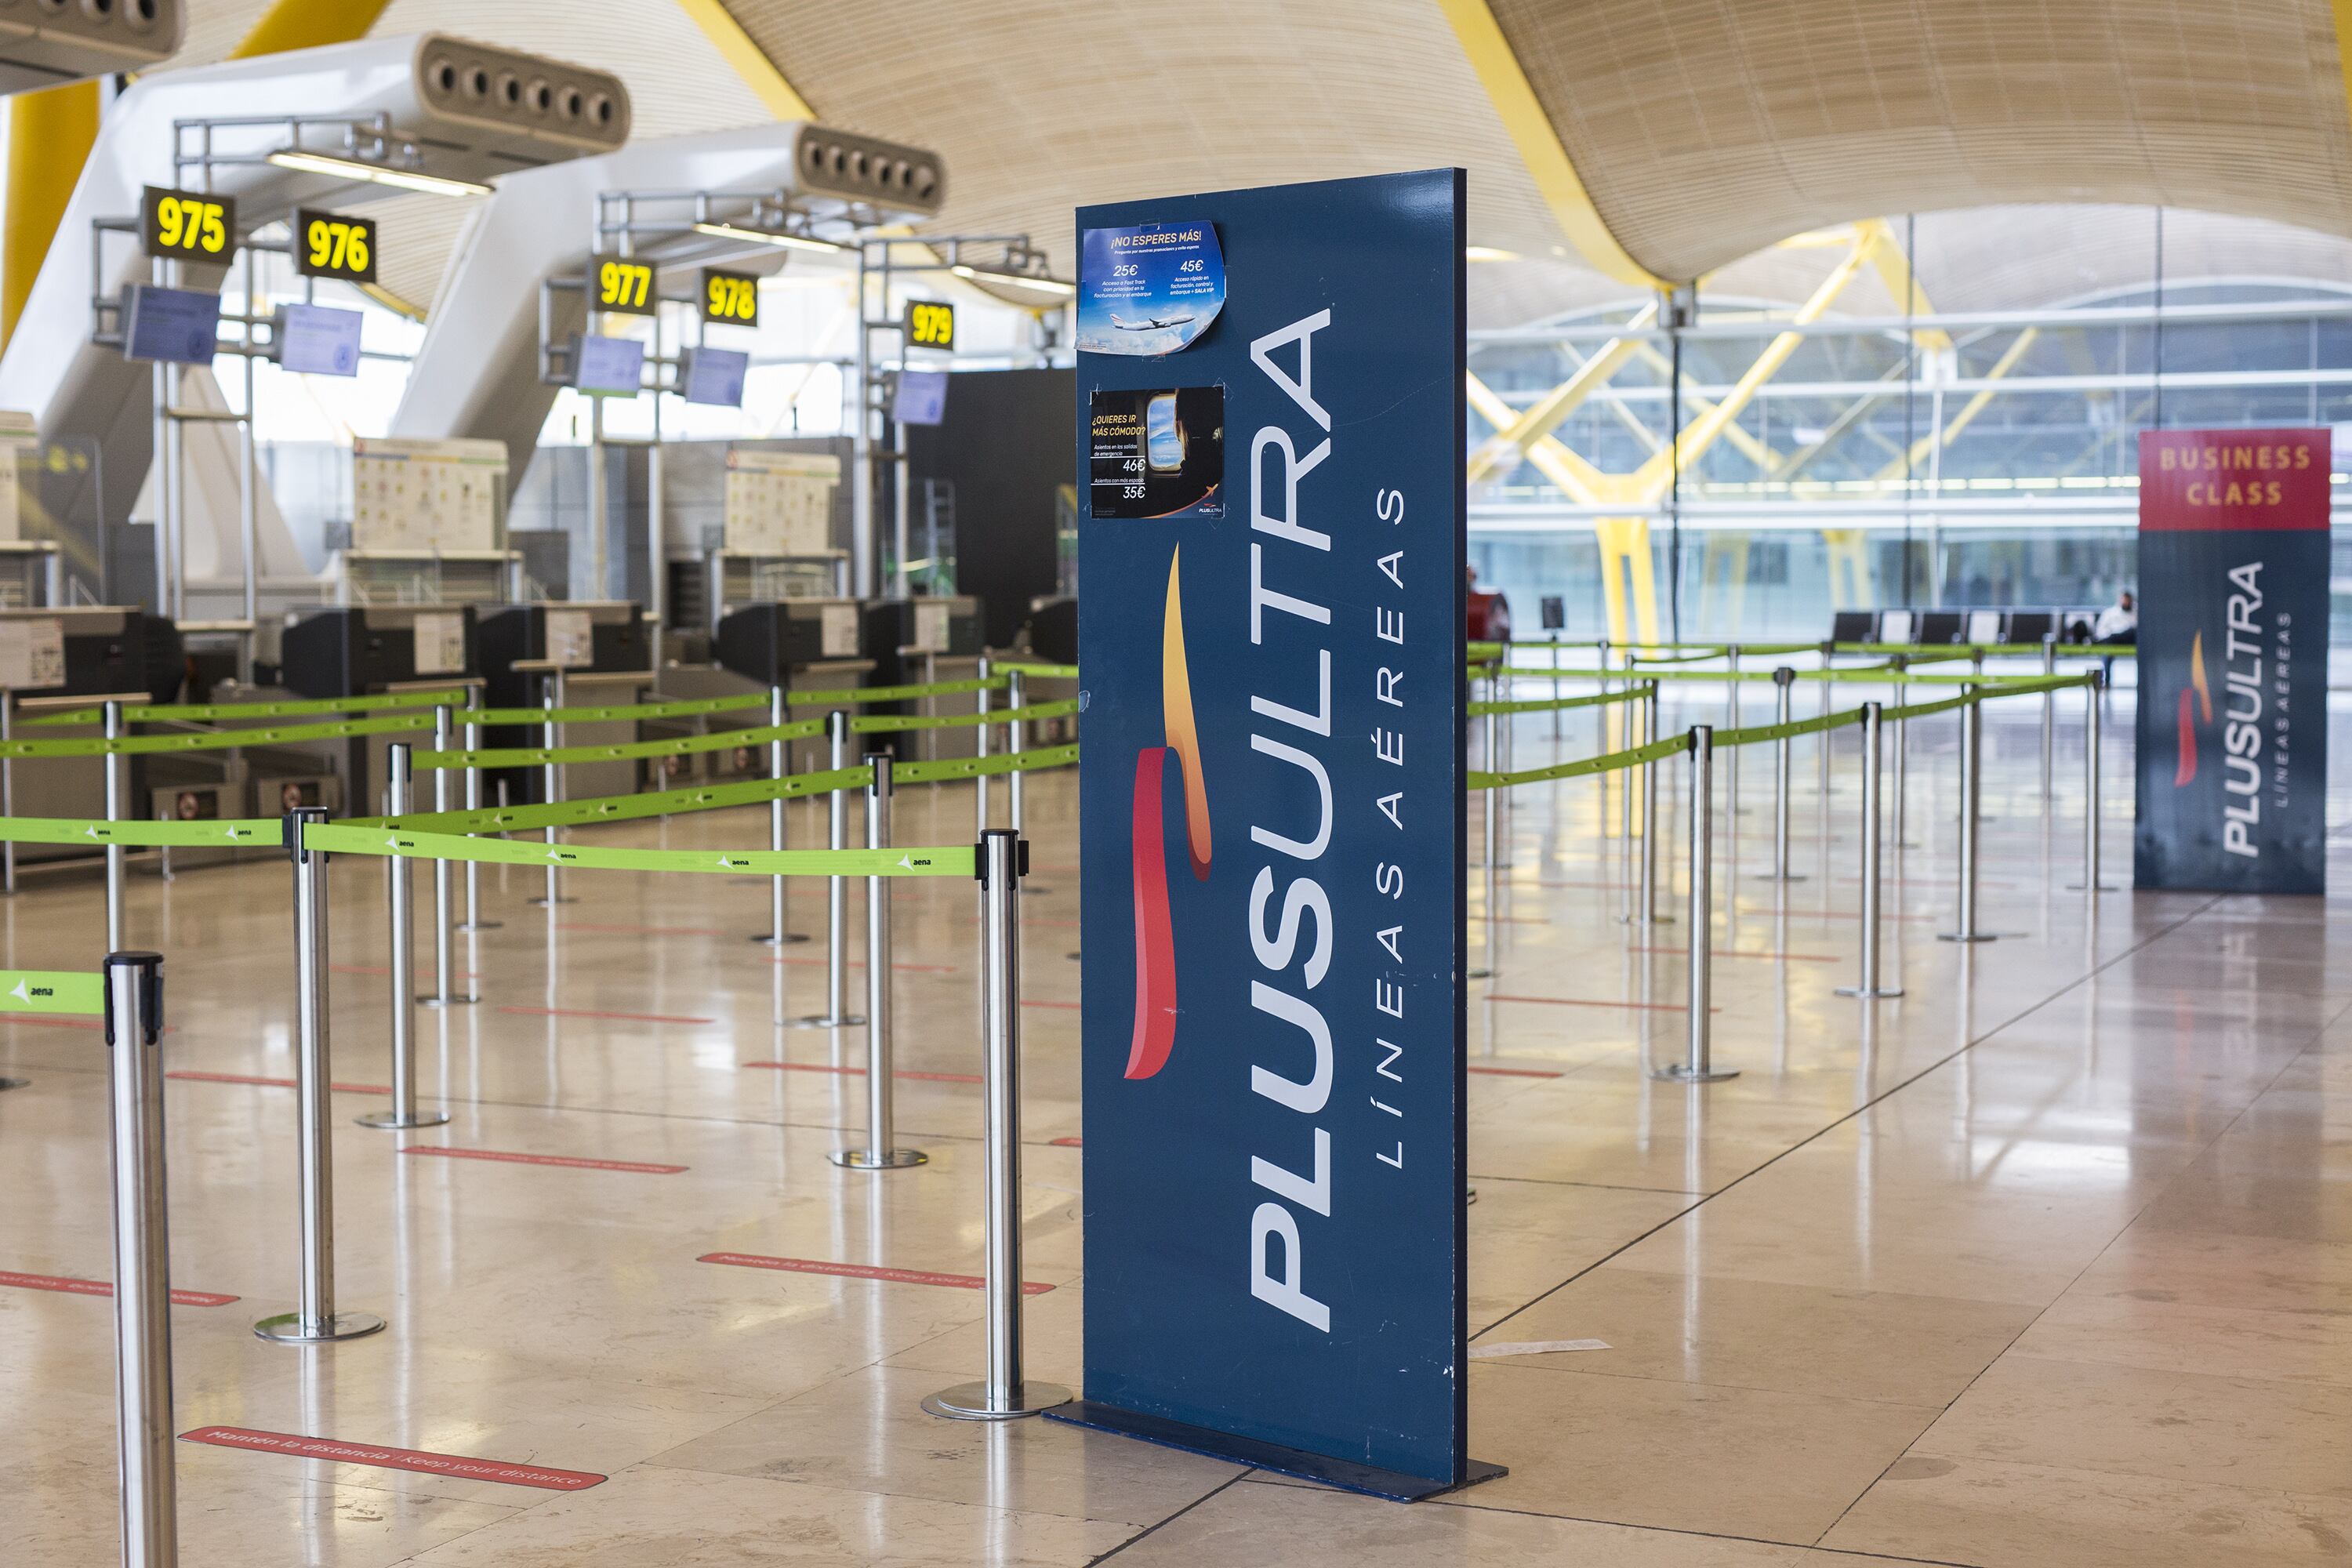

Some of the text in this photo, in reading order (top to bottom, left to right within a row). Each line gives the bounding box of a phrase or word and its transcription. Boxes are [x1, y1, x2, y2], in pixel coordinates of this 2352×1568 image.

[158, 196, 225, 253] 975
[1111, 229, 1202, 249] ¡NO ESPERES MÁS!
[307, 220, 369, 272] 976
[1113, 264, 1138, 277] 25€
[1180, 260, 1203, 272] 45€
[601, 261, 652, 308] 977
[708, 275, 756, 320] 978
[913, 303, 953, 345] 979
[1092, 415, 1127, 426] ¿QUIERES
[1092, 426, 1146, 437] MÁS CÓMODO?
[1123, 459, 1146, 471] 46€
[2160, 445, 2310, 470] BUSINESS
[1123, 486, 1146, 499] 35€
[2187, 481, 2282, 506] CLASS
[2223, 561, 2264, 858] PLUSULTRA
[1249, 308, 1333, 1334] PLUSULTRA
[1370, 487, 1405, 1169] LÍNEAS AÉREAS
[207, 1431, 278, 1446] Mantén
[280, 1440, 300, 1449] la
[303, 1443, 390, 1460] distancia
[401, 1455, 449, 1468] Keep
[452, 1463, 499, 1474] your
[499, 1468, 582, 1485] distance
